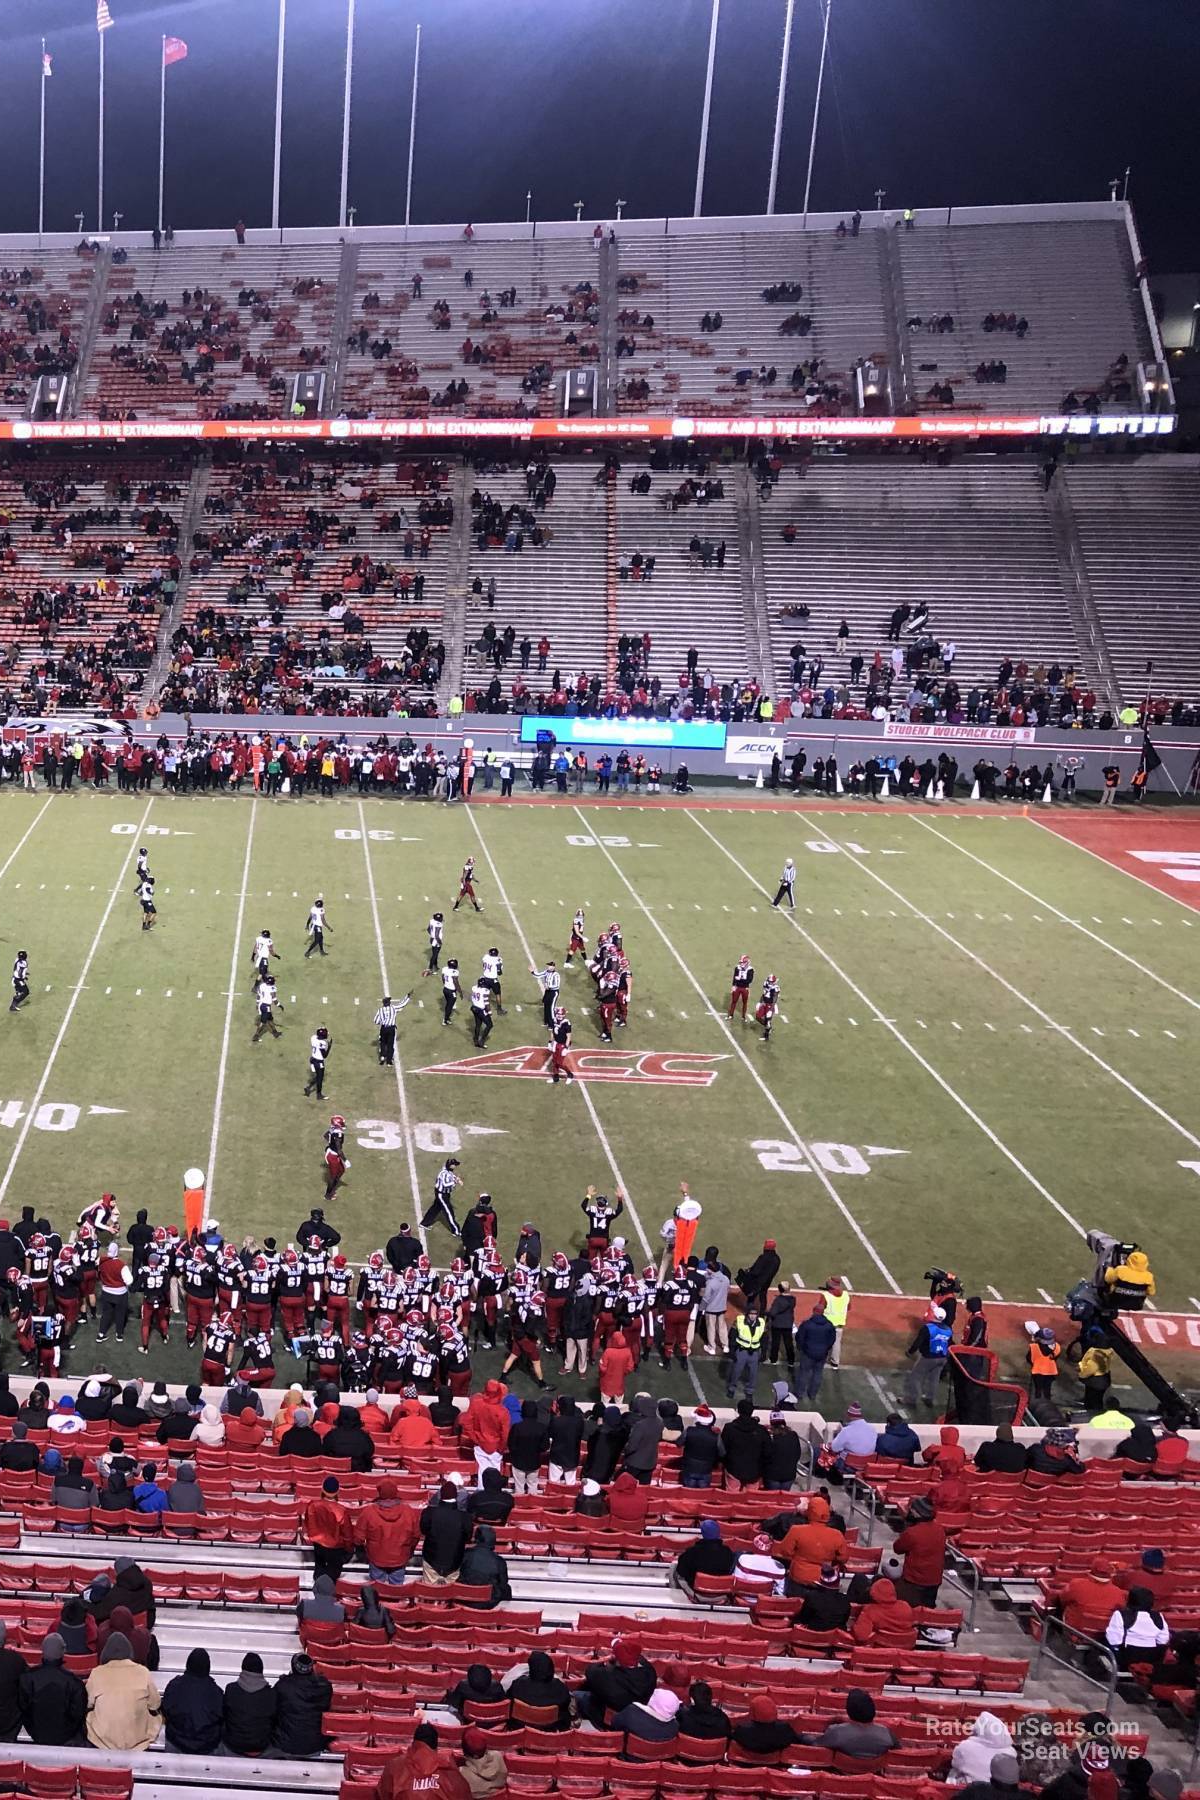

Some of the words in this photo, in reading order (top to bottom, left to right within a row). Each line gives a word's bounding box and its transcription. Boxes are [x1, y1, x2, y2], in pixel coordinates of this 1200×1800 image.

[103, 425, 122, 436] THE
[427, 423, 445, 434] THE
[697, 421, 731, 434] THINK
[732, 421, 755, 434] AND
[776, 421, 797, 434] THE
[887, 725, 931, 736] STUDENT
[933, 727, 989, 738] WOLFPACK
[990, 729, 1016, 739] CLUB
[1124, 735, 1132, 743] 8
[738, 743, 777, 753] ACCN
[405, 1046, 734, 1087] ACC
[356, 1119, 463, 1153] 30
[750, 1139, 872, 1176] 20
[593, 1218, 607, 1230] 14
[308, 1262, 325, 1275] 89
[147, 1276, 163, 1288] 95
[186, 1271, 202, 1286] 70
[287, 1277, 301, 1287] 61
[495, 1279, 503, 1291] 7
[555, 1276, 570, 1289] 65
[251, 1282, 269, 1294] 68
[330, 1280, 346, 1294] 82
[379, 1296, 398, 1310] 38
[673, 1294, 691, 1305] 95
[207, 1335, 225, 1352] 45
[317, 1346, 335, 1360] 90
[412, 1362, 432, 1378] 98
